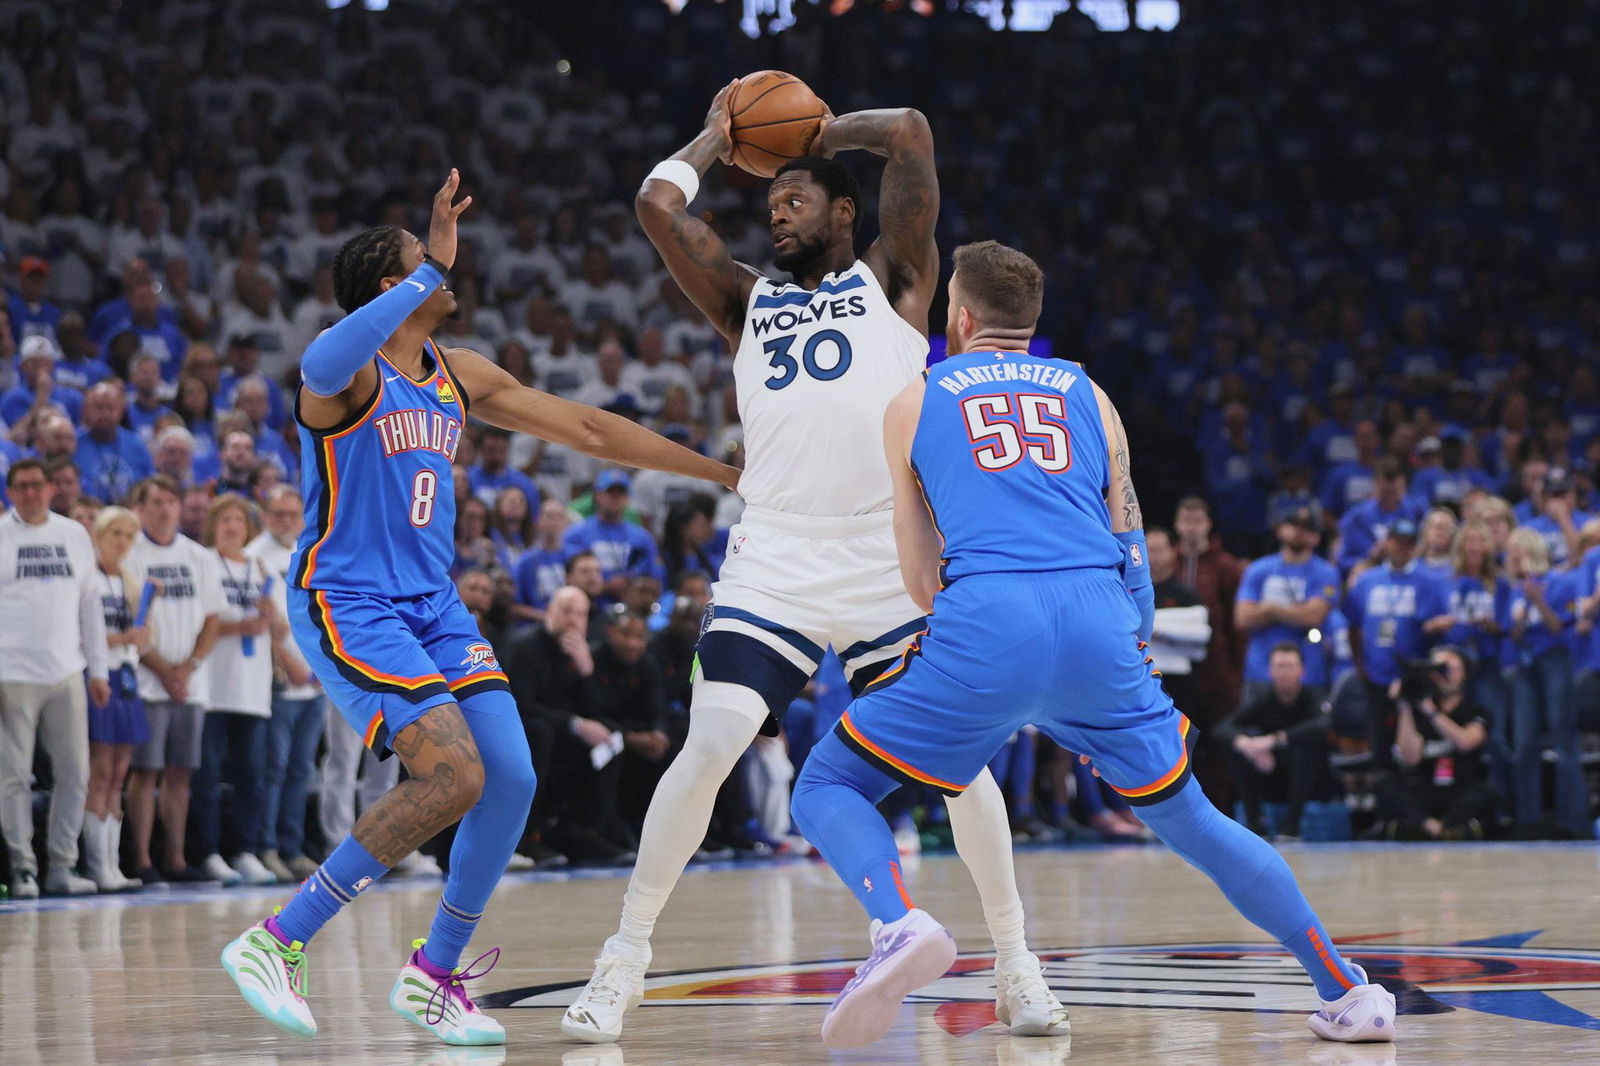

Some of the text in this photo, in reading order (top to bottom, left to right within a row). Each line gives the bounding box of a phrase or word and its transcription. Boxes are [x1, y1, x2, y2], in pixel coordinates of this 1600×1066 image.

[752, 295, 867, 338] WOLVES
[763, 329, 853, 391] 30
[937, 362, 1078, 396] HARTENSTEIN
[373, 408, 462, 465] THUNDER
[959, 392, 1072, 474] 55
[409, 468, 438, 528] 8
